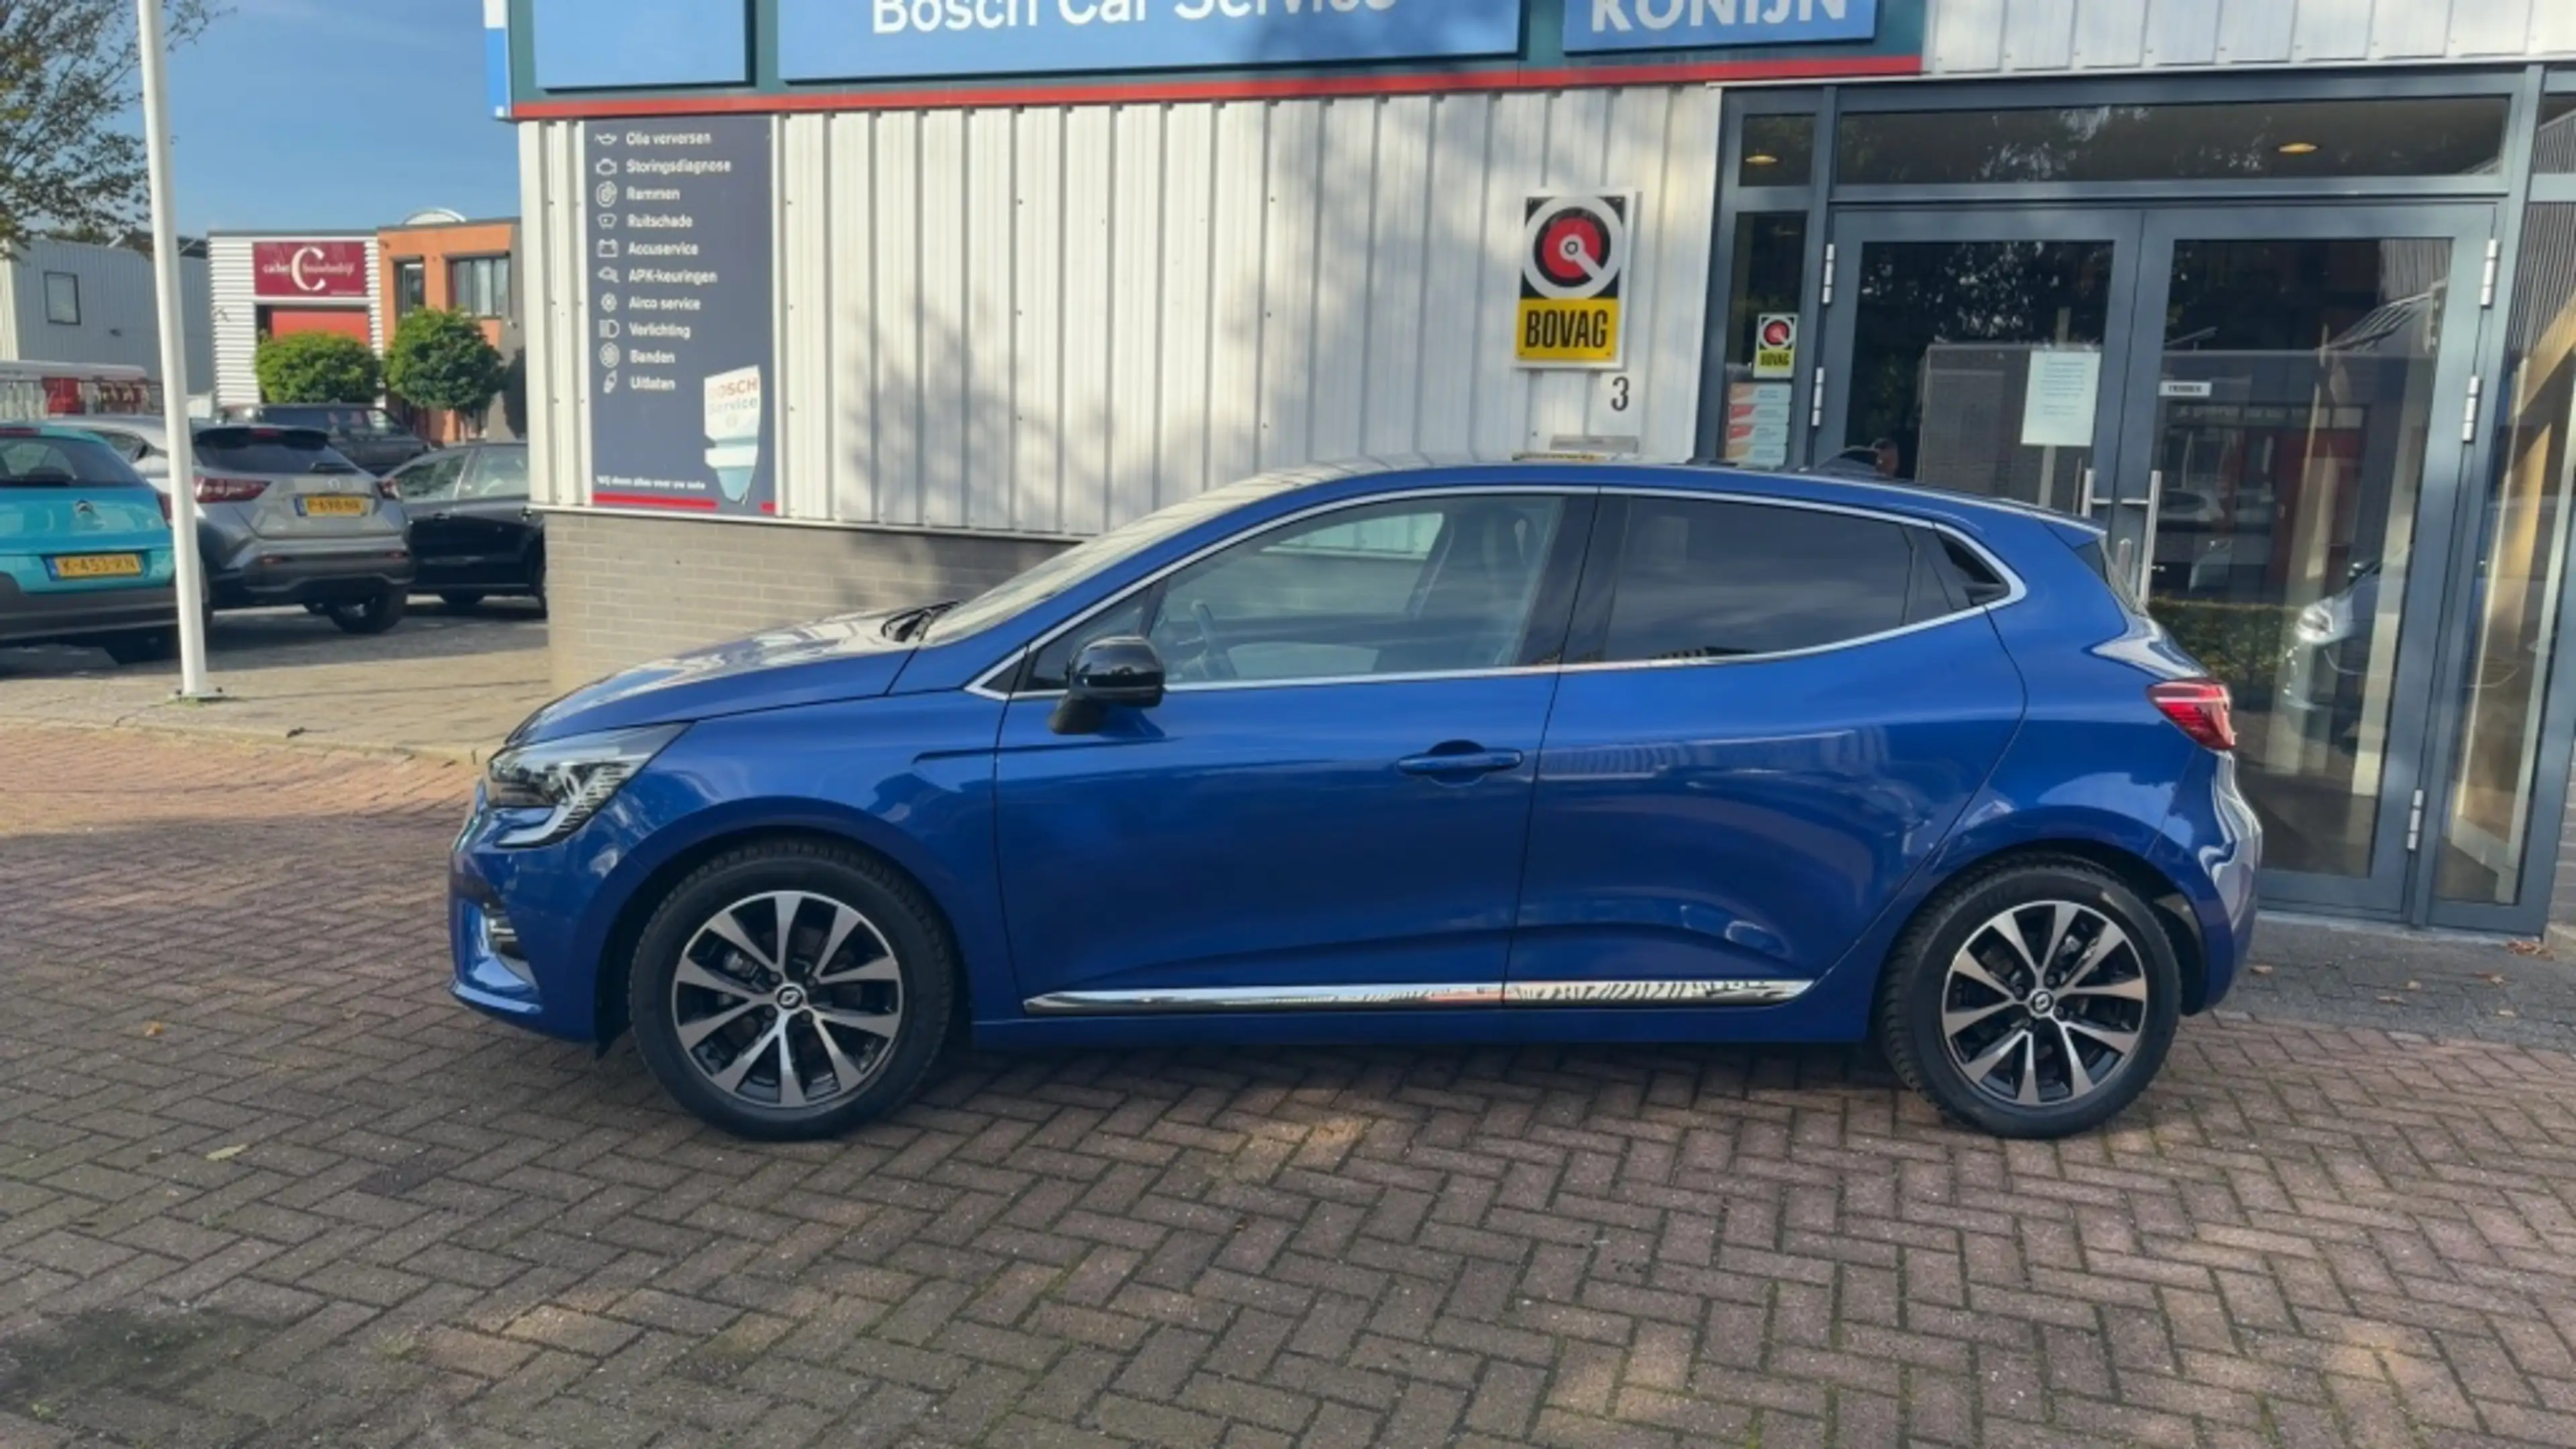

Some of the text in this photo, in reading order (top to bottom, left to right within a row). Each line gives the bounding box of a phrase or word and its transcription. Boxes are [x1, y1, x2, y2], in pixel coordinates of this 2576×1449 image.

[873, 0, 1037, 33] Bosch
[626, 132, 711, 146] Olie verversen
[626, 159, 731, 175] Storingsdiagnose
[627, 214, 693, 228] Ruitschade
[628, 241, 698, 255] Accuservice
[629, 269, 718, 286] APK-keuringen
[629, 297, 701, 311] Airco service
[629, 323, 691, 340] Verlichting
[1525, 309, 1608, 348] BOVAG
[630, 350, 676, 364] Banden
[1760, 352, 1790, 366] BOVAG
[631, 376, 676, 390] Uitlaten
[1611, 376, 1629, 412] 3
